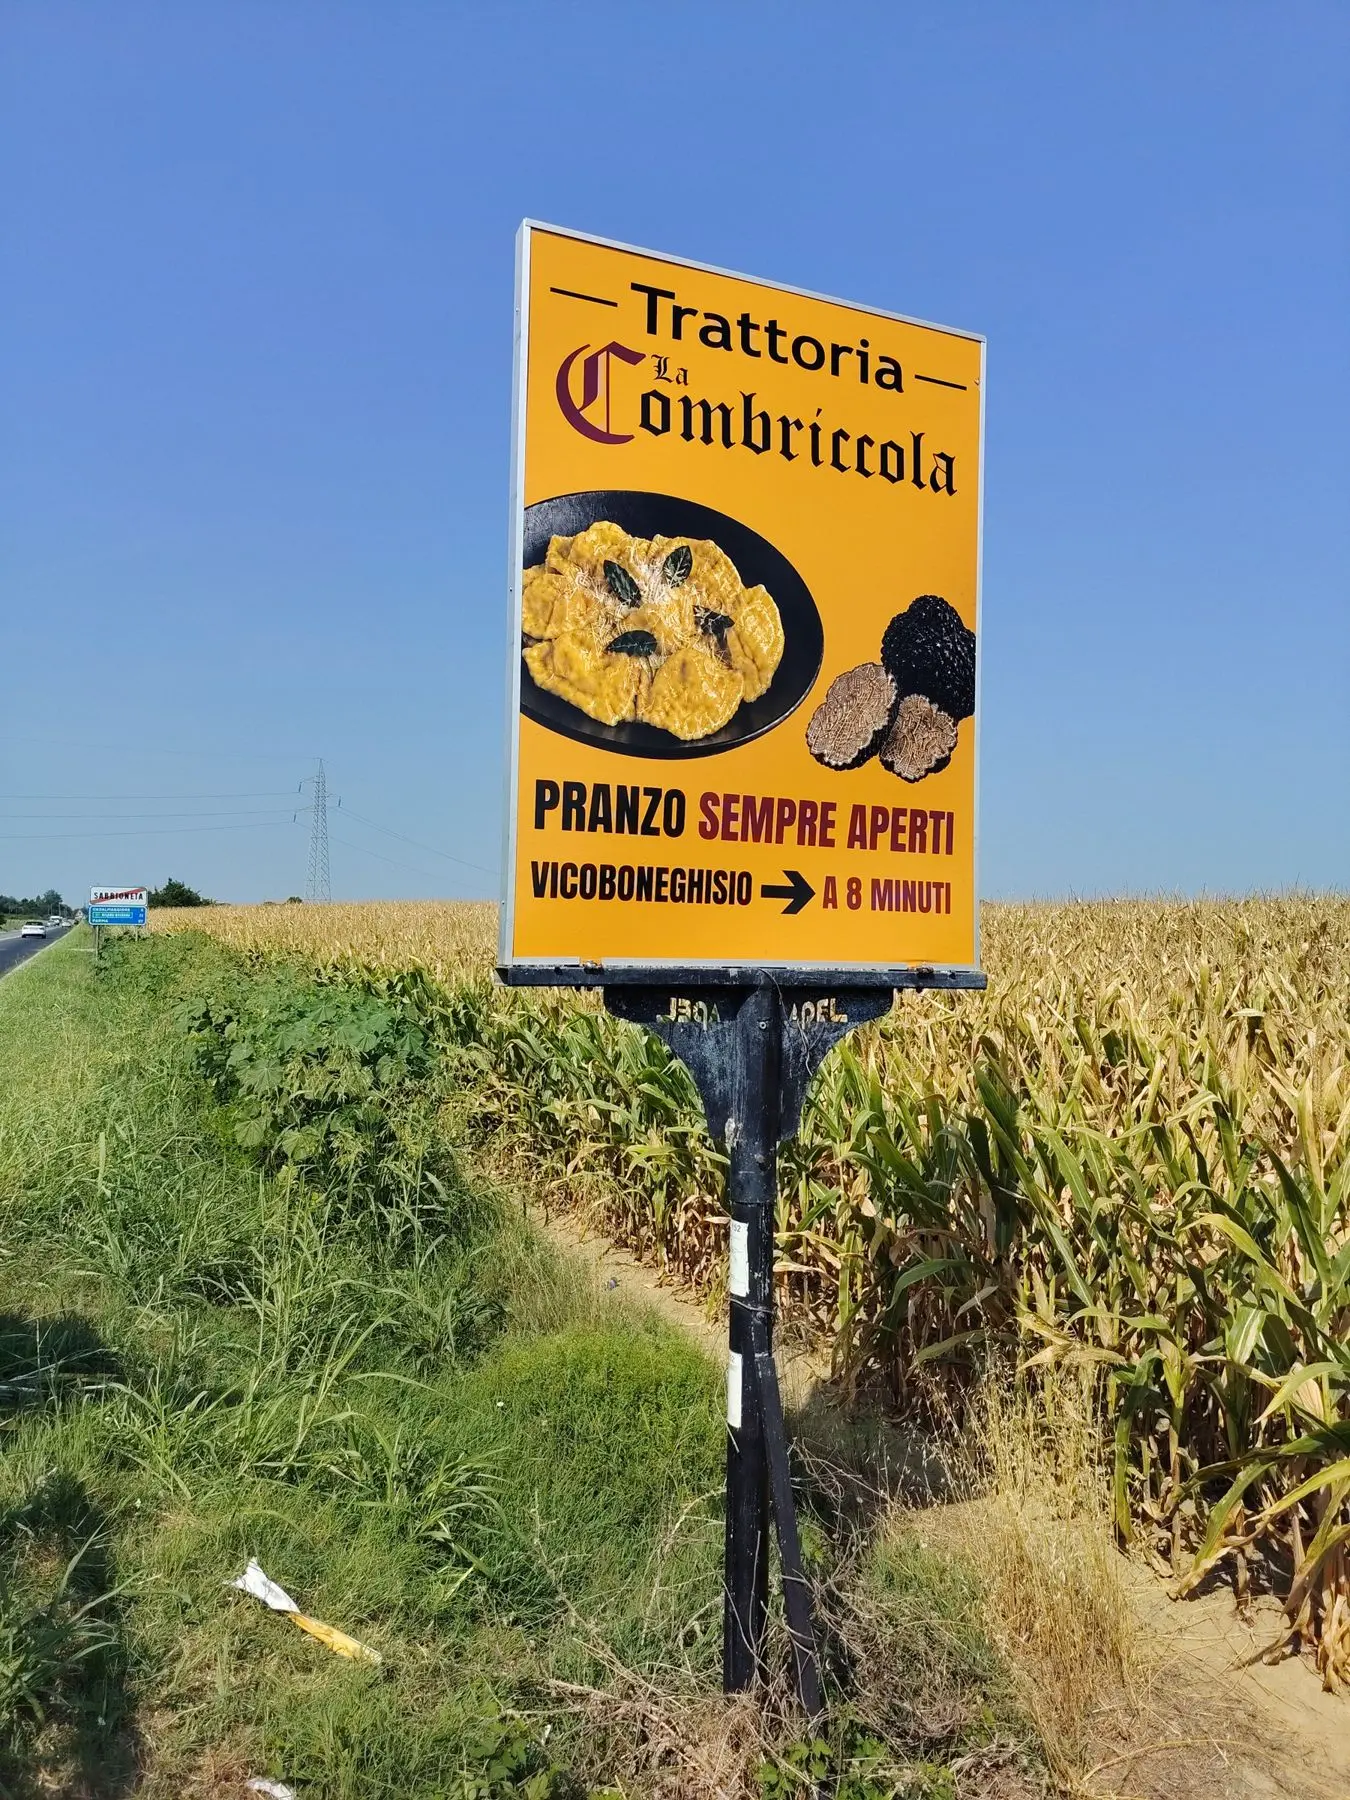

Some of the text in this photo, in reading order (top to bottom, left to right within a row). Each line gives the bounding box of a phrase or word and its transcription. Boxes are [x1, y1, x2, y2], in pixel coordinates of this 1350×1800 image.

[630, 282, 904, 393] Trattoria
[651, 354, 689, 386] La
[555, 341, 958, 497] Combriccola
[534, 779, 954, 855] PRANZO SEMPRE APERTI
[94, 892, 143, 900] SABBIONETA
[530, 860, 951, 915] VICOBONEGHISIO A 8 MINUTI
